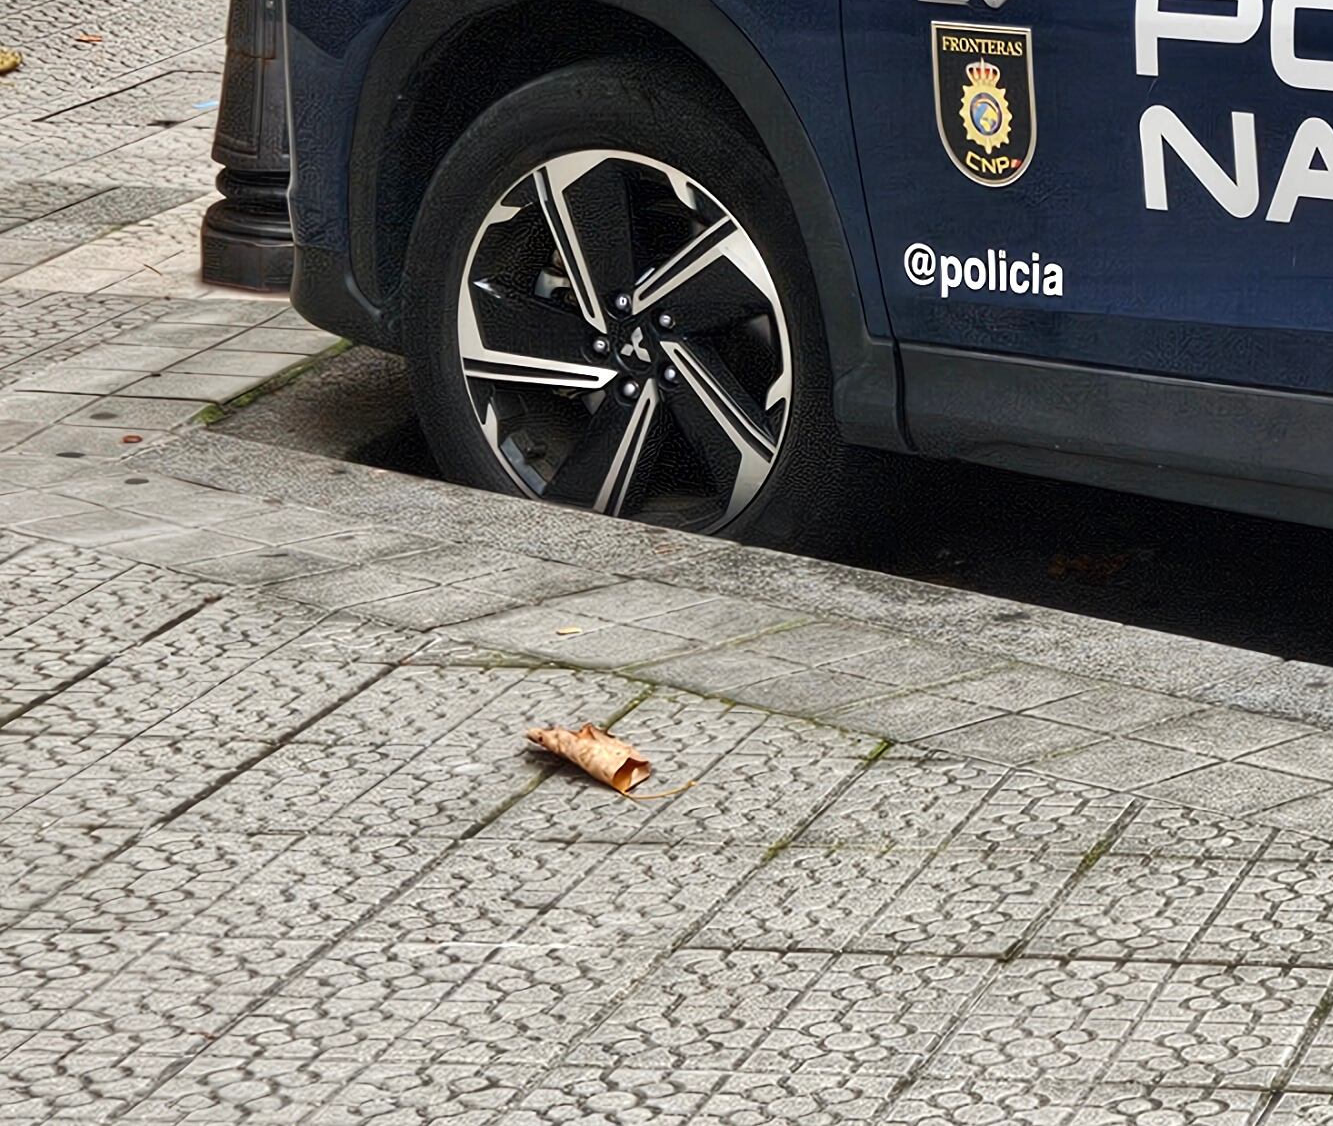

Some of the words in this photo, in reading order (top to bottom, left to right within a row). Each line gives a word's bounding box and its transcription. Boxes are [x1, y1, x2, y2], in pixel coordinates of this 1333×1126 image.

[942, 36, 1023, 56] FRONTERAS
[965, 151, 1010, 174] CNP
[904, 242, 1064, 298] @policia
